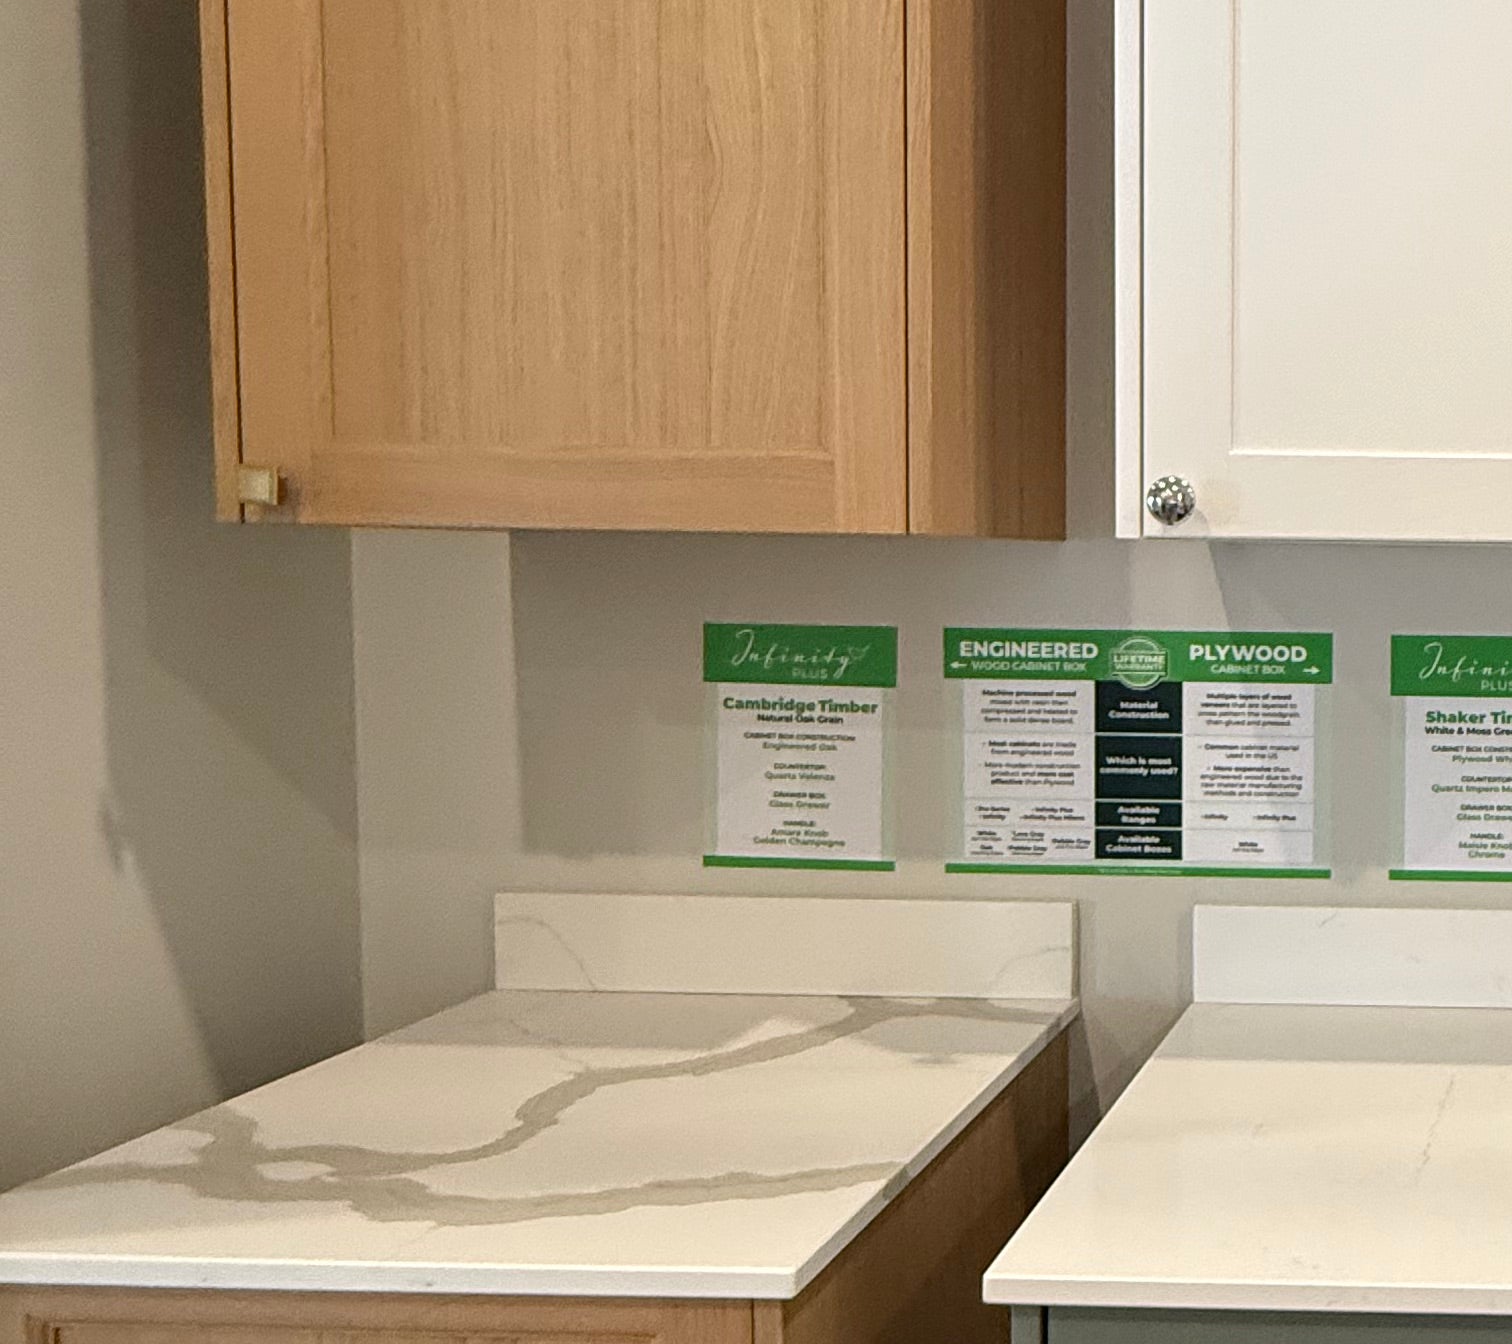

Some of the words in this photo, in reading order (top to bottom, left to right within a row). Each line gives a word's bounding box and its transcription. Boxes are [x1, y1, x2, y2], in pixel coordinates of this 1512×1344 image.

[731, 629, 850, 679] Infinity
[959, 640, 1098, 659] ENGINEERED
[1189, 644, 1307, 663] PLYWOOD
[1113, 655, 1166, 664] LIFETIME
[971, 661, 1009, 671] WOOD
[1012, 661, 1060, 671] CABINET
[1063, 662, 1087, 672] BOX
[1210, 664, 1259, 675] CABINET
[1261, 665, 1286, 675] BOX
[723, 696, 816, 714] Cambridge
[818, 699, 878, 713] Timber
[1120, 701, 1158, 709] Material
[757, 714, 793, 723] Natural
[795, 715, 815, 723] Oak
[818, 715, 844, 724] Grain
[1108, 710, 1170, 719] Construction
[1426, 711, 1486, 724] Shaker
[1425, 726, 1455, 735] White
[1456, 726, 1464, 735] &
[1467, 727, 1491, 735] Moss
[1105, 756, 1137, 765] Which
[1138, 757, 1147, 765] is
[1148, 757, 1172, 765] most
[1150, 767, 1178, 776] used?
[1117, 806, 1160, 815] Available
[1118, 835, 1160, 844] Available
[1105, 844, 1142, 853] Cabinet
